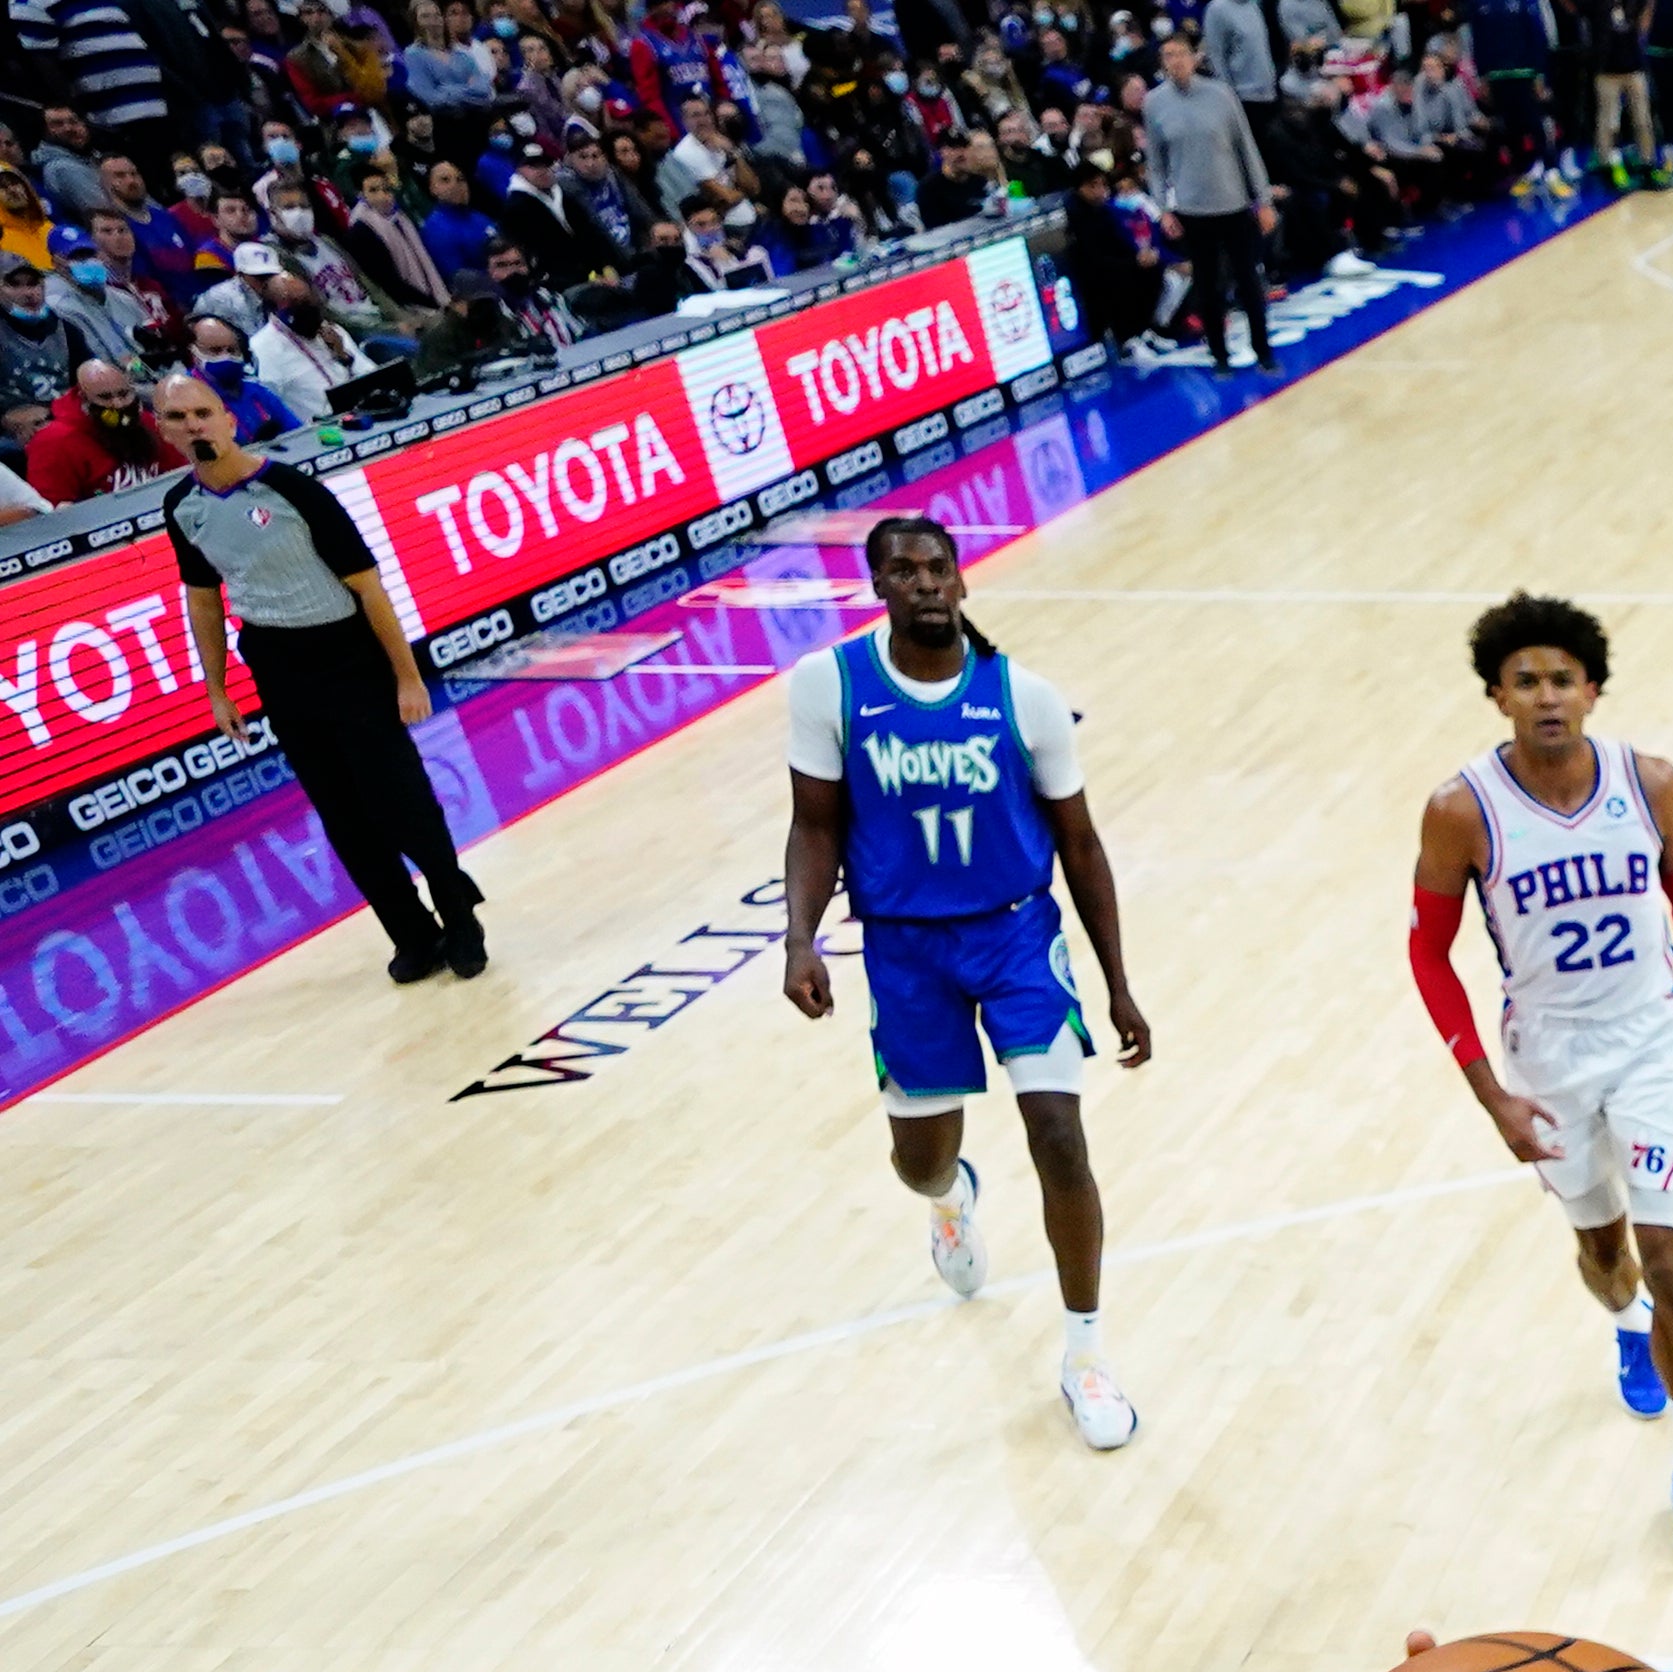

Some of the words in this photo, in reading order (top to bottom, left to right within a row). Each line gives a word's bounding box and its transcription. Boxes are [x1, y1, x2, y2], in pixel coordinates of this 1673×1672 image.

[786, 301, 974, 426] TOYOTA
[416, 412, 685, 575] TOYOTA
[68, 755, 188, 832] GEICO
[429, 608, 515, 669] GEICO
[530, 566, 608, 624] GEICO
[608, 533, 681, 586] GEICO
[861, 731, 1001, 797] WOLVES
[912, 803, 974, 867] 11
[1550, 913, 1636, 973] 22
[1631, 1141, 1665, 1174] 76
